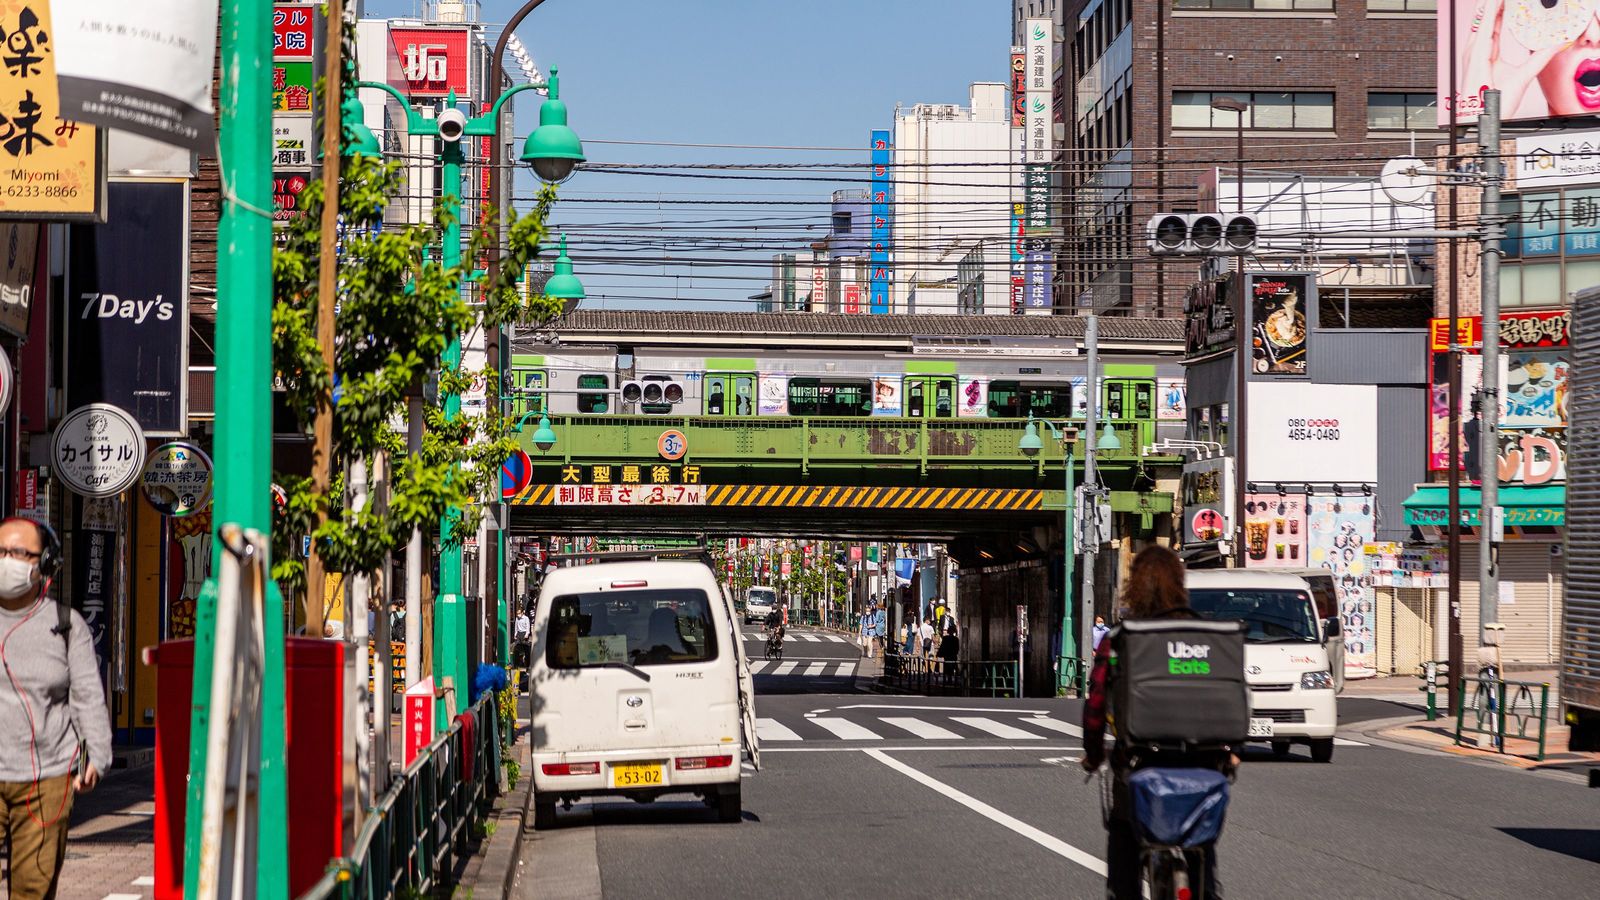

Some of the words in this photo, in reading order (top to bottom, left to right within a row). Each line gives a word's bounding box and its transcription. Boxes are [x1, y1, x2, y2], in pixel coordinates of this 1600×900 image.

[1034, 45, 1044, 88] 交通建設
[1034, 117, 1044, 160] 交通建設
[1560, 142, 1600, 161] 総合
[11, 169, 60, 183] Miyomi
[0, 186, 77, 198] -6233-8866
[814, 266, 824, 302] HOTEL
[1288, 418, 1306, 427] 080
[1288, 428, 1340, 440] 4654-0480
[61, 444, 134, 463] カイサル
[85, 474, 110, 487] Cafe
[144, 470, 209, 484] 韓流茶房
[562, 465, 700, 483] 大型最徐行
[182, 495, 195, 505] 3F
[560, 486, 633, 503] 制限高さ
[1412, 509, 1447, 522] K-POP
[1167, 641, 1210, 658] Uber
[1168, 658, 1210, 674] Eats
[624, 770, 660, 784] 53-02
